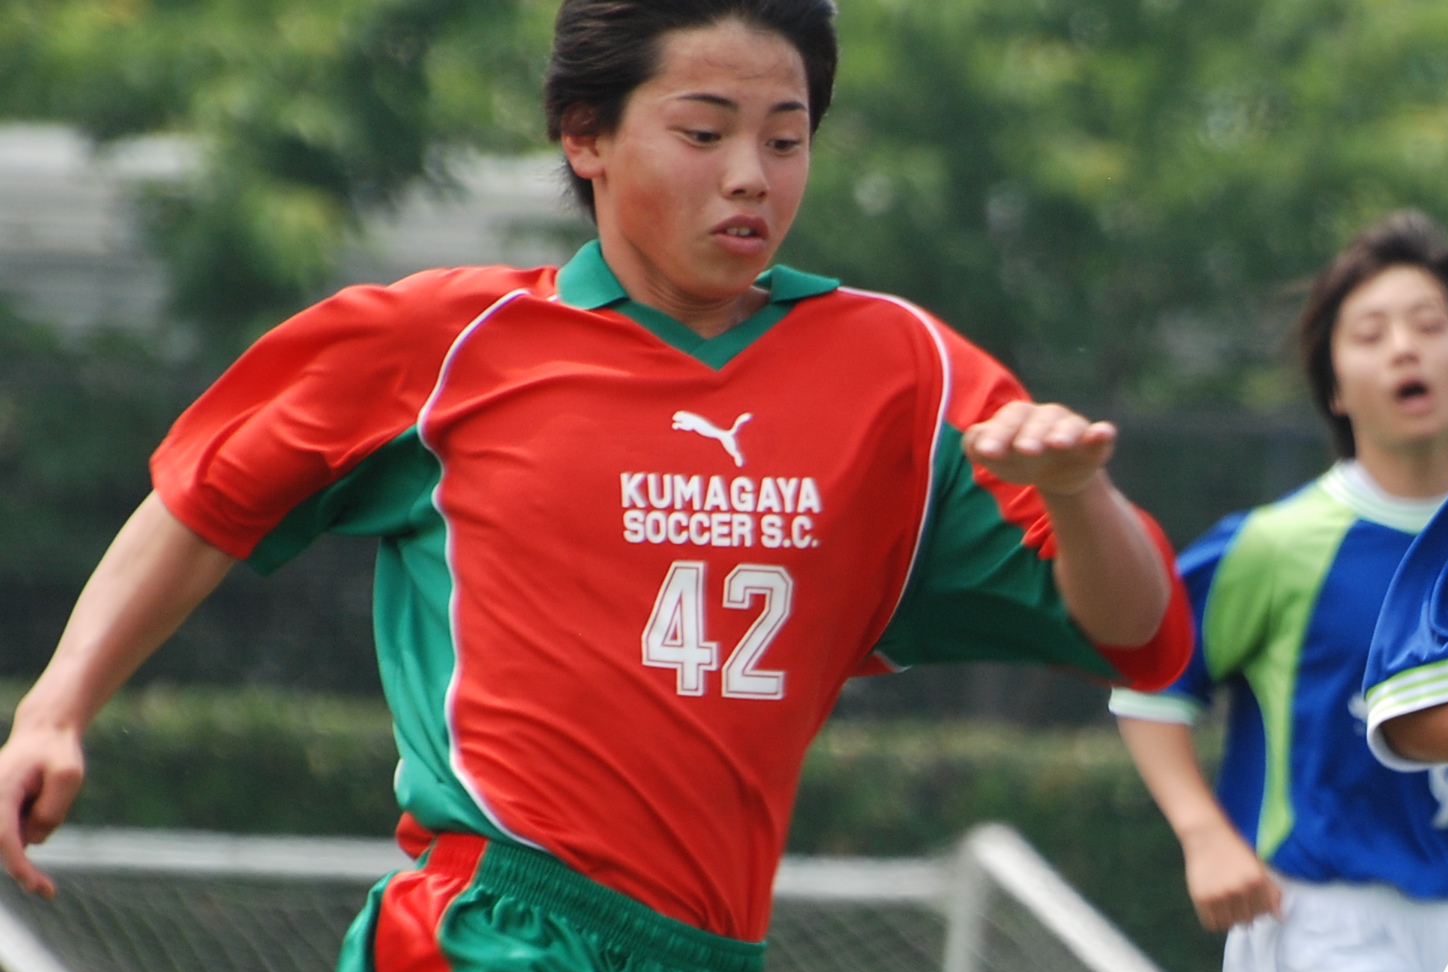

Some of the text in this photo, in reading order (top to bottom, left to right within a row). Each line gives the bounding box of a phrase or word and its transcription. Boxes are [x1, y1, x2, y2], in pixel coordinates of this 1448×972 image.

[620, 472, 822, 513] KUMAGAYA
[623, 510, 820, 549] SOCCER S.C.
[641, 560, 793, 700] 42
